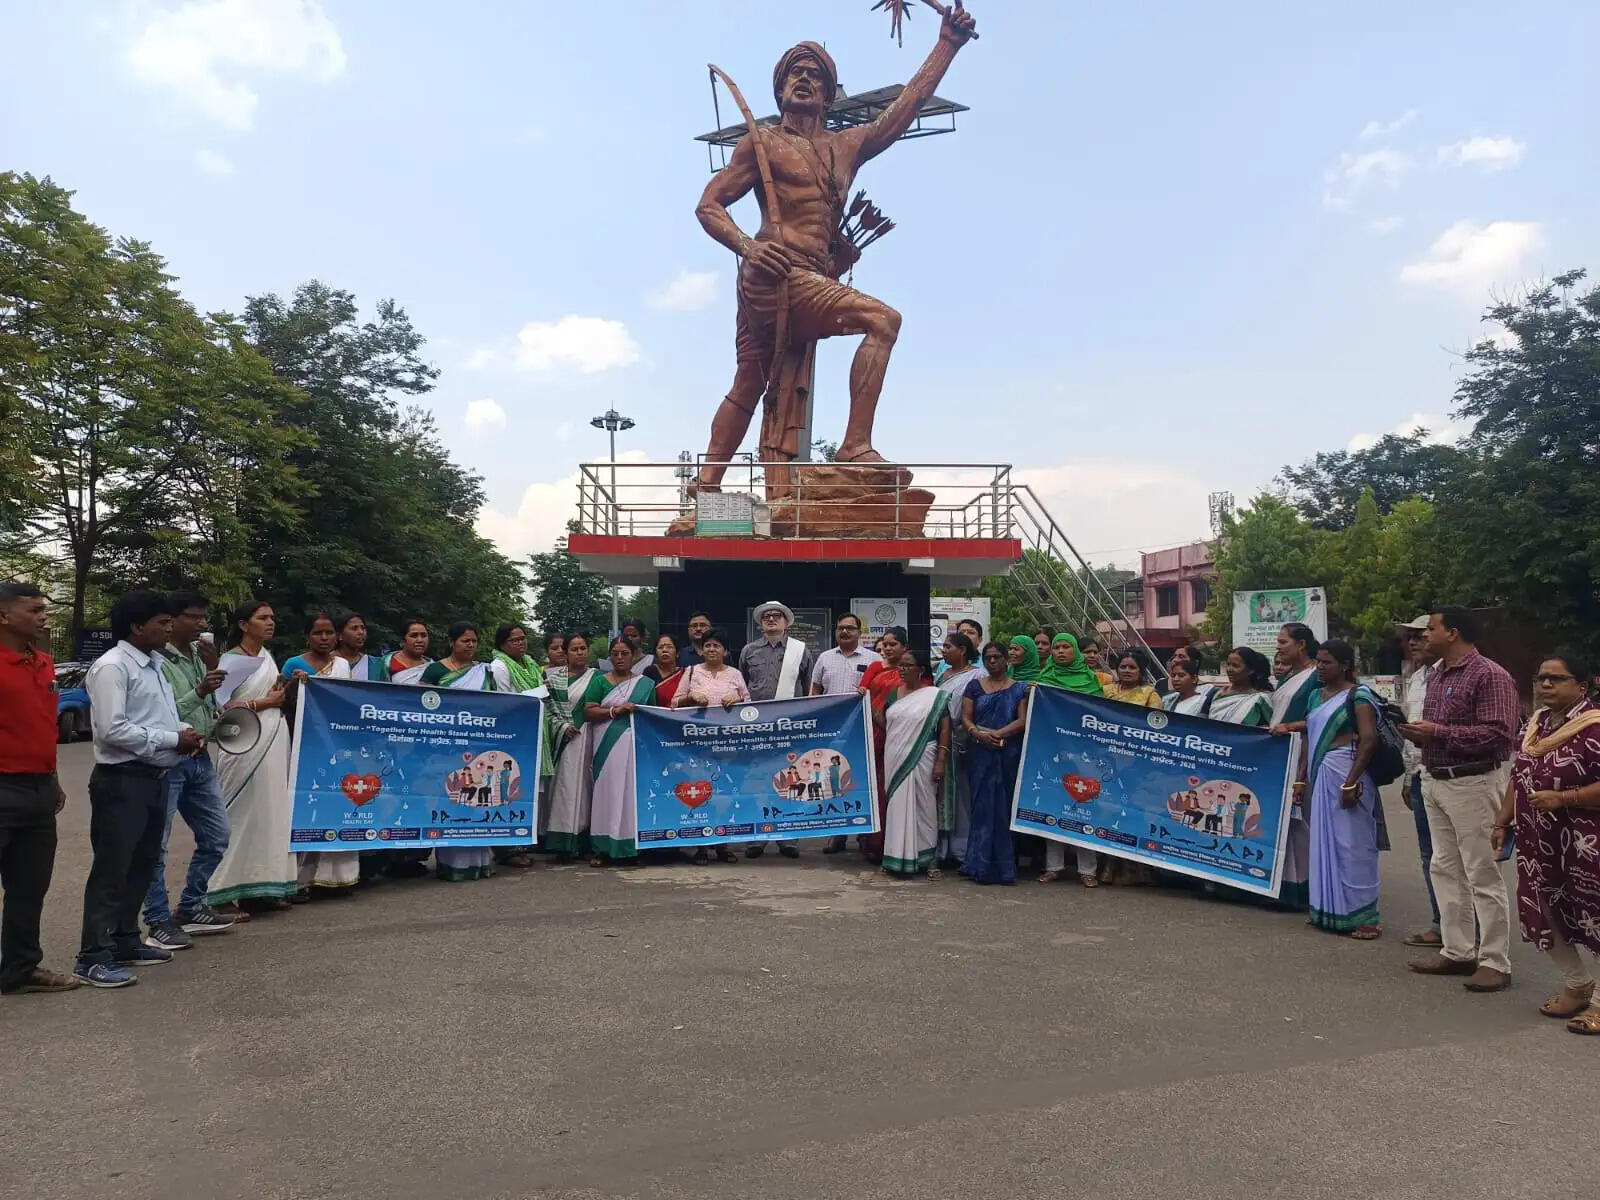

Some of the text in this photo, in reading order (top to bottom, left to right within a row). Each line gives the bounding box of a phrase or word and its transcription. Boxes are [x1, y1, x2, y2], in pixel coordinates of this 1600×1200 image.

[329, 722, 359, 731] Theme
[360, 704, 497, 727] विश्व स्वास्थ्य दिवस
[682, 717, 818, 736] विश्व स्वास्थ्य दिवस
[1055, 726, 1081, 737] Theme
[1127, 741, 1139, 750] for
[1140, 744, 1170, 755] Health:
[1171, 751, 1196, 761] Stand
[1197, 757, 1216, 765] with
[1081, 714, 1233, 757] विश्व स्वास्थ्य दिवस
